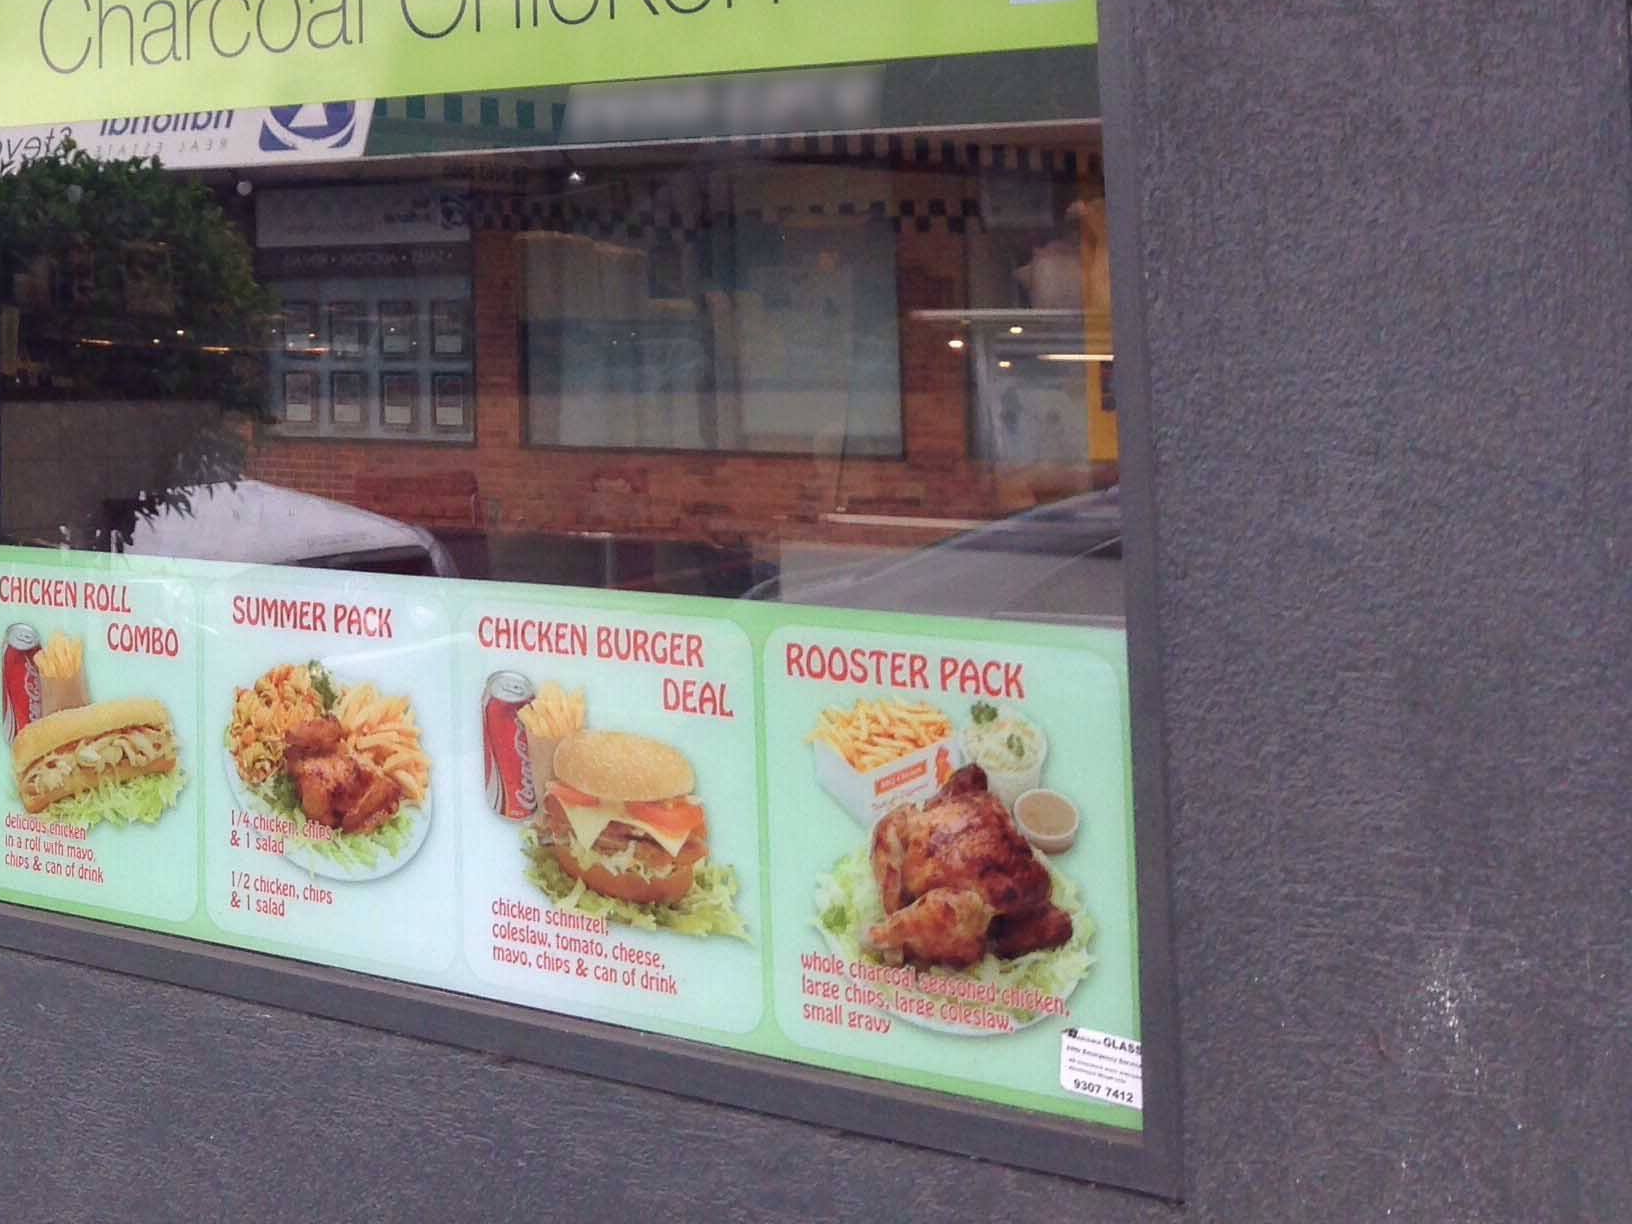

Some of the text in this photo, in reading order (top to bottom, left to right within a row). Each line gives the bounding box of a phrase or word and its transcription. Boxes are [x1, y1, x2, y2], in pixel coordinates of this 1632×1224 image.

[84, 582, 132, 614] ROLL
[232, 595, 393, 639] SUMMER PACK
[107, 623, 180, 658] COMBO
[477, 615, 705, 669] CHICKEN BURGER
[786, 643, 1025, 699] ROOSTER PACK
[662, 678, 734, 718] DEAL
[4, 812, 87, 841] delicious chicken
[231, 809, 250, 827] 1/4
[4, 834, 14, 848] in
[16, 837, 23, 849] a
[24, 836, 42, 853] roll
[43, 840, 64, 857] with
[230, 829, 240, 847] &
[255, 836, 285, 854] salad
[4, 850, 104, 884] chips & can of drink
[230, 890, 240, 909] &
[255, 898, 285, 917] salad
[231, 871, 333, 906] 1/2 chicken, chips
[491, 896, 609, 936] chicken schnitzel,
[491, 921, 666, 970] coleslaw, tomato, cheese,
[492, 944, 679, 996] mayo, chips & can of drink
[800, 951, 845, 976] whole
[849, 960, 918, 991] charcoal
[923, 973, 997, 1004] seasoned
[801, 974, 1016, 1033] large chips, large coleslaw,
[802, 1000, 892, 1035] small gravy
[1103, 1036, 1142, 1056] GLASS
[1073, 1078, 1134, 1104] 9307 7412
